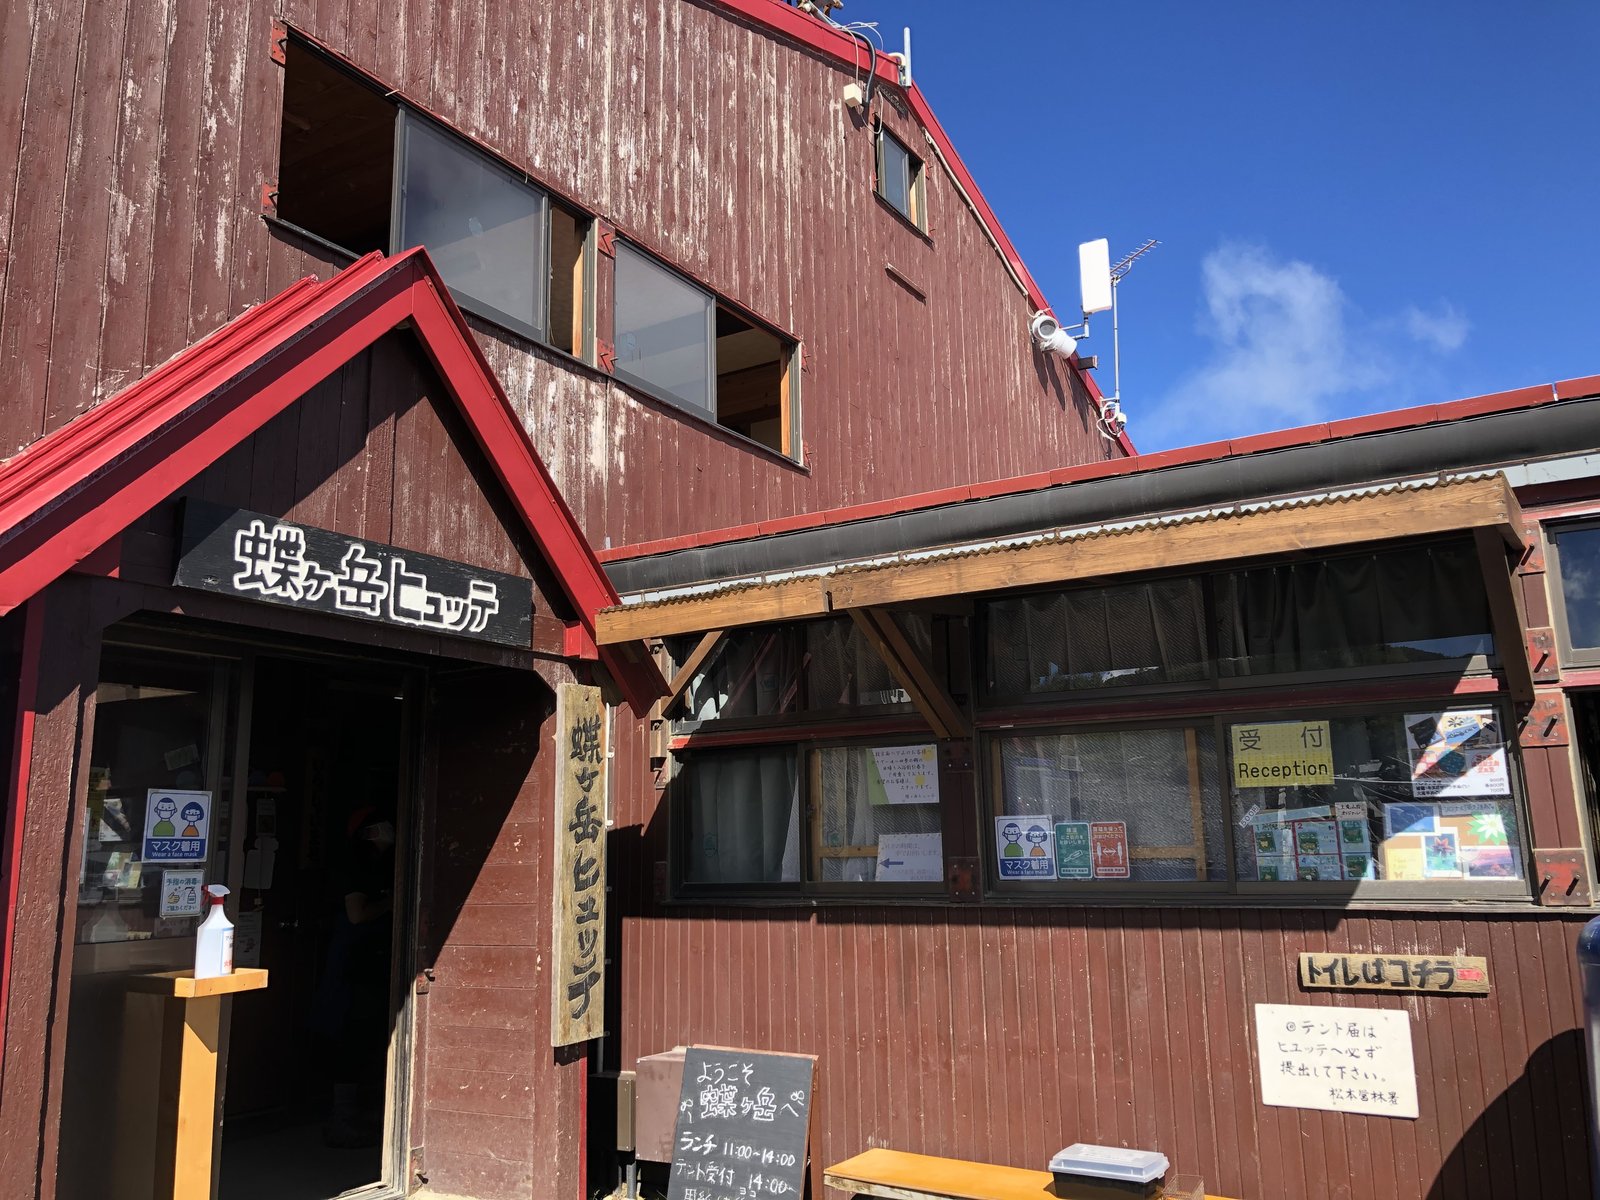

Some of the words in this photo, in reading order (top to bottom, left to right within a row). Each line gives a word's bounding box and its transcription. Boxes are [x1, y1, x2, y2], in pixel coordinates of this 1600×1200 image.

[1239, 761, 1328, 779] Reception
[151, 840, 200, 852] マスク着用
[1005, 860, 1049, 870] マスク着用
[1308, 956, 1455, 990] トイレはコチラ
[697, 1061, 754, 1085] ようこそ
[1280, 1061, 1387, 1082] 提出して下さい。
[1329, 1087, 1400, 1105] 松本営林署
[680, 1131, 718, 1155] ランチ
[675, 1158, 735, 1186] テント受付
